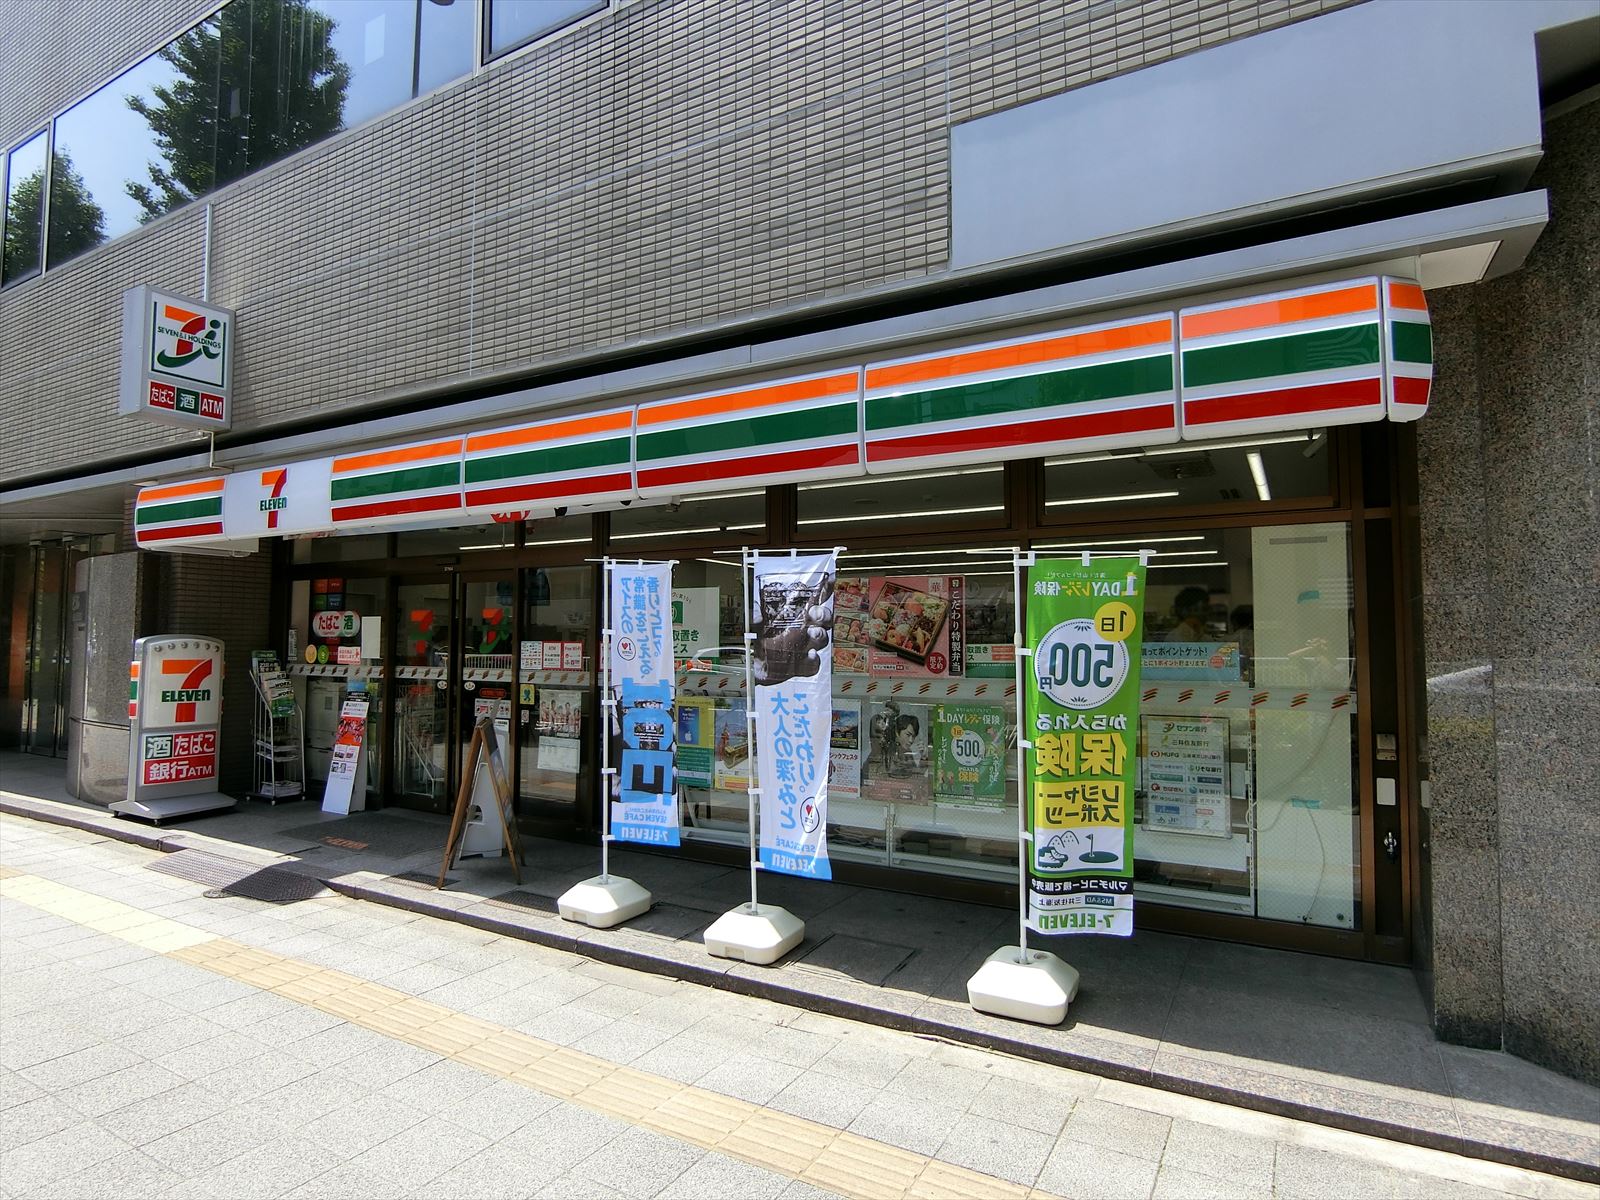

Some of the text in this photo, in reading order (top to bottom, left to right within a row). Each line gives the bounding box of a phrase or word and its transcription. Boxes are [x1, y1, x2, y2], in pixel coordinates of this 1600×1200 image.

[157, 326, 179, 338] SEVEN
[187, 335, 222, 349] HOLDINGS
[151, 387, 223, 415] たばこ 酒 ATM
[318, 615, 354, 630] たばこ 酒
[147, 734, 215, 759] 酒 たばこ
